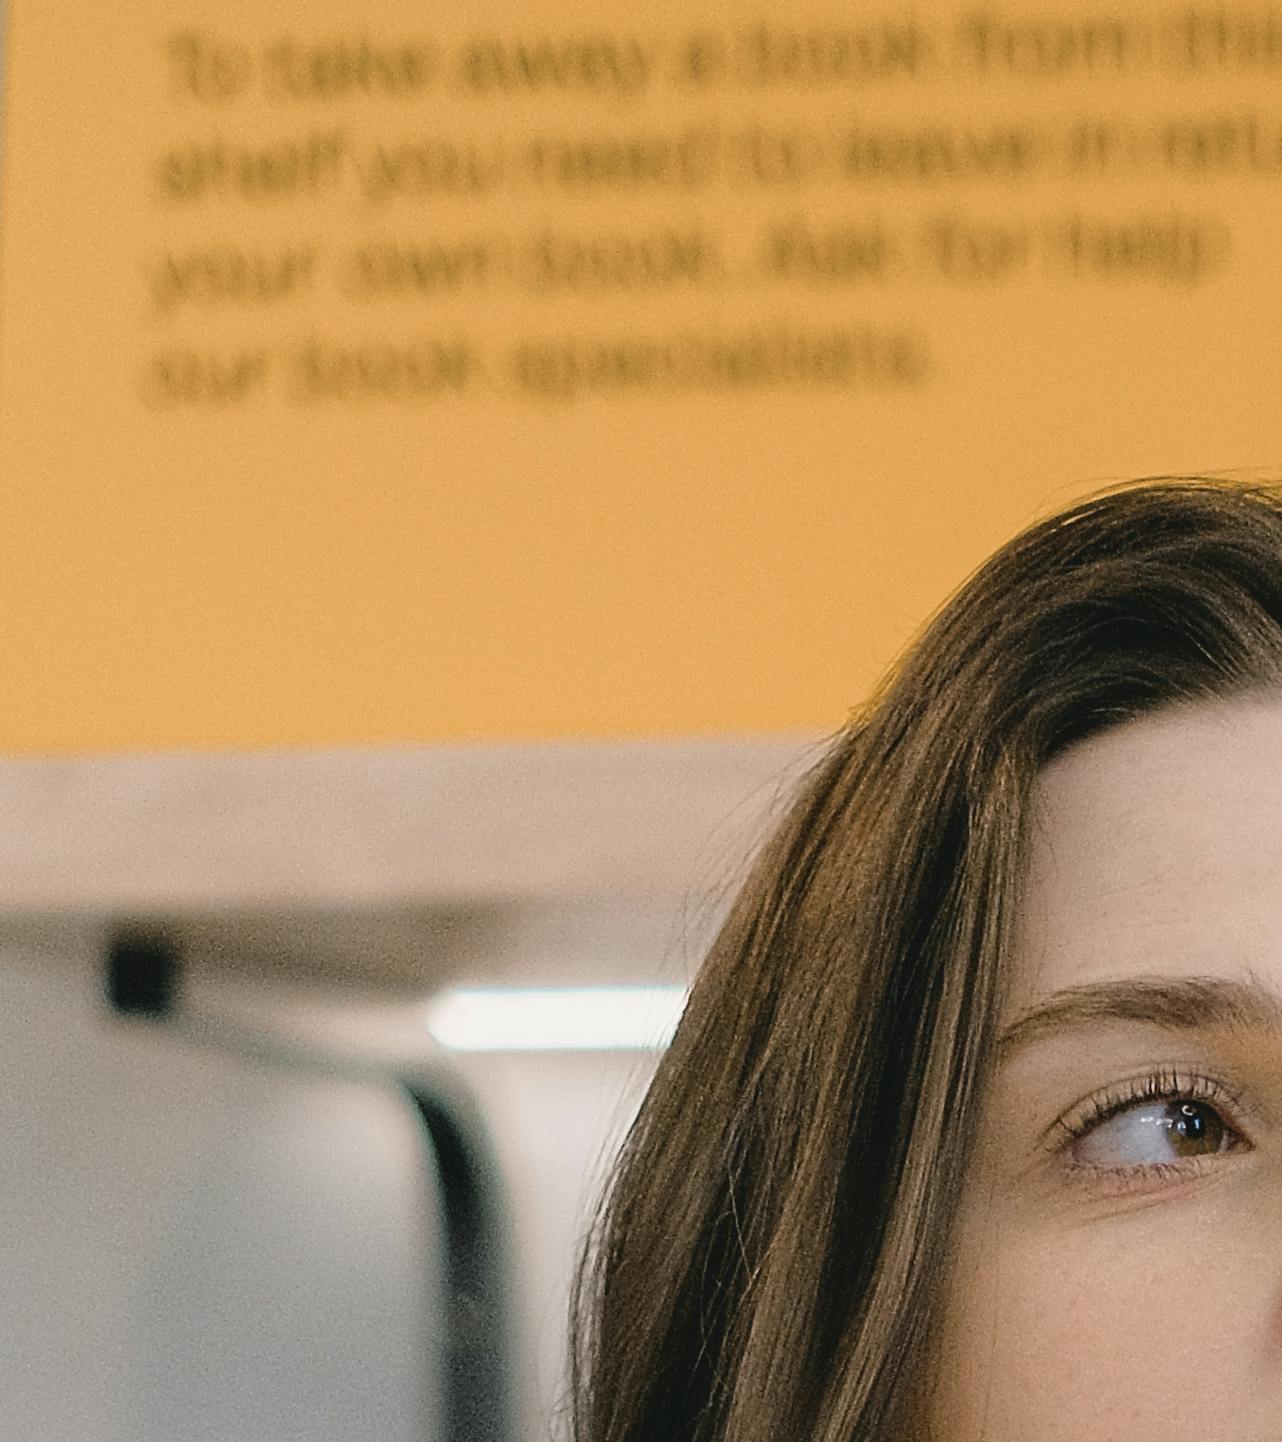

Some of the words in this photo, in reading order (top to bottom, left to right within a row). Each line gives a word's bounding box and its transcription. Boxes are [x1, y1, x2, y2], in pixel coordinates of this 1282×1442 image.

[167, 30, 243, 104] To
[262, 26, 436, 104] take
[455, 30, 656, 112] away
[678, 42, 722, 90] a
[740, 16, 928, 92] book
[954, 6, 1132, 80] from
[152, 122, 346, 202] shelf
[354, 140, 493, 214] you
[525, 114, 714, 192] need
[742, 110, 808, 182] to
[834, 108, 1040, 180] leave
[1066, 106, 1132, 174] in
[145, 234, 318, 318] your
[342, 234, 494, 298] own
[758, 212, 894, 284] Ask
[920, 210, 1032, 286] for
[1048, 208, 1232, 290] help
[140, 344, 270, 408] our
[290, 334, 478, 402] book
